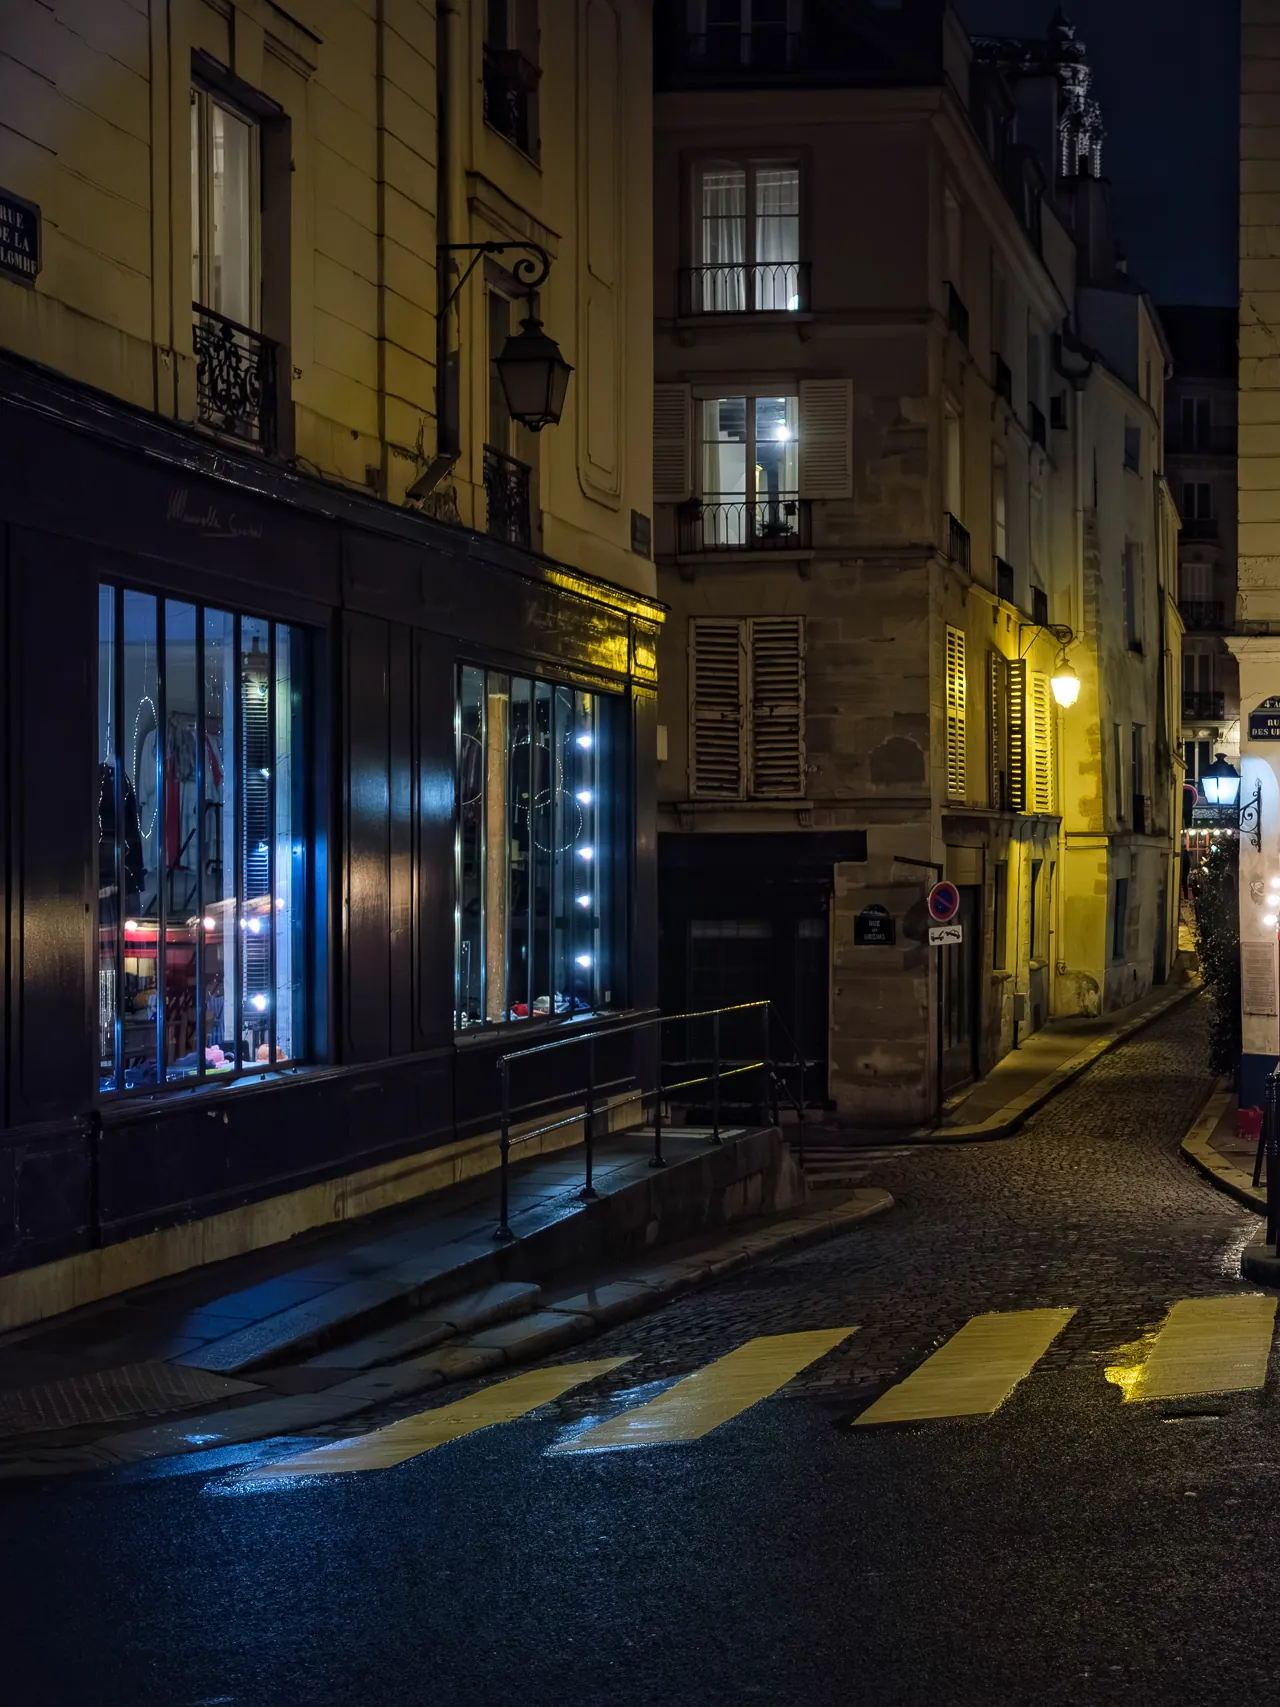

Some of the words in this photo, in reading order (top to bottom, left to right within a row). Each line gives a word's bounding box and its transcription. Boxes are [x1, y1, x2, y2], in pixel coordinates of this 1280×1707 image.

[0, 225, 10, 243] E
[15, 231, 30, 252] LA
[1252, 728, 1269, 736] DES
